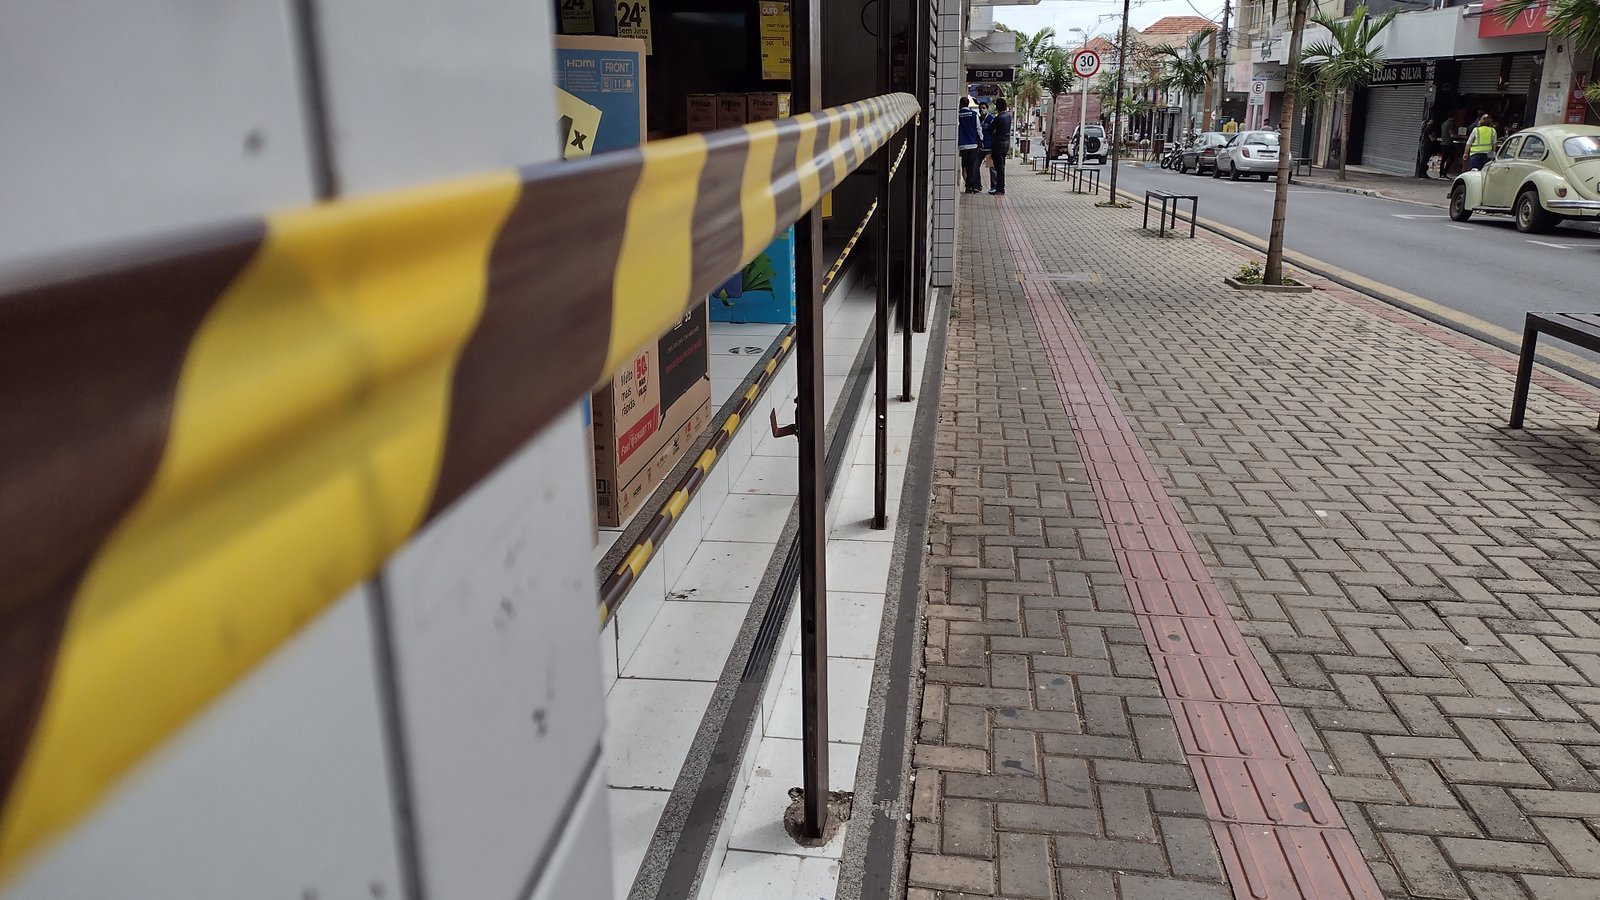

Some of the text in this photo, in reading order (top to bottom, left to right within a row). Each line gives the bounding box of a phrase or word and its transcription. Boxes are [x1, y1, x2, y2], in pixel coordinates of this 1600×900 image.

[1080, 55, 1095, 67] 30
[605, 62, 629, 73] FRONT
[1372, 68, 1397, 82] LOJAS
[1256, 83, 1262, 92] E
